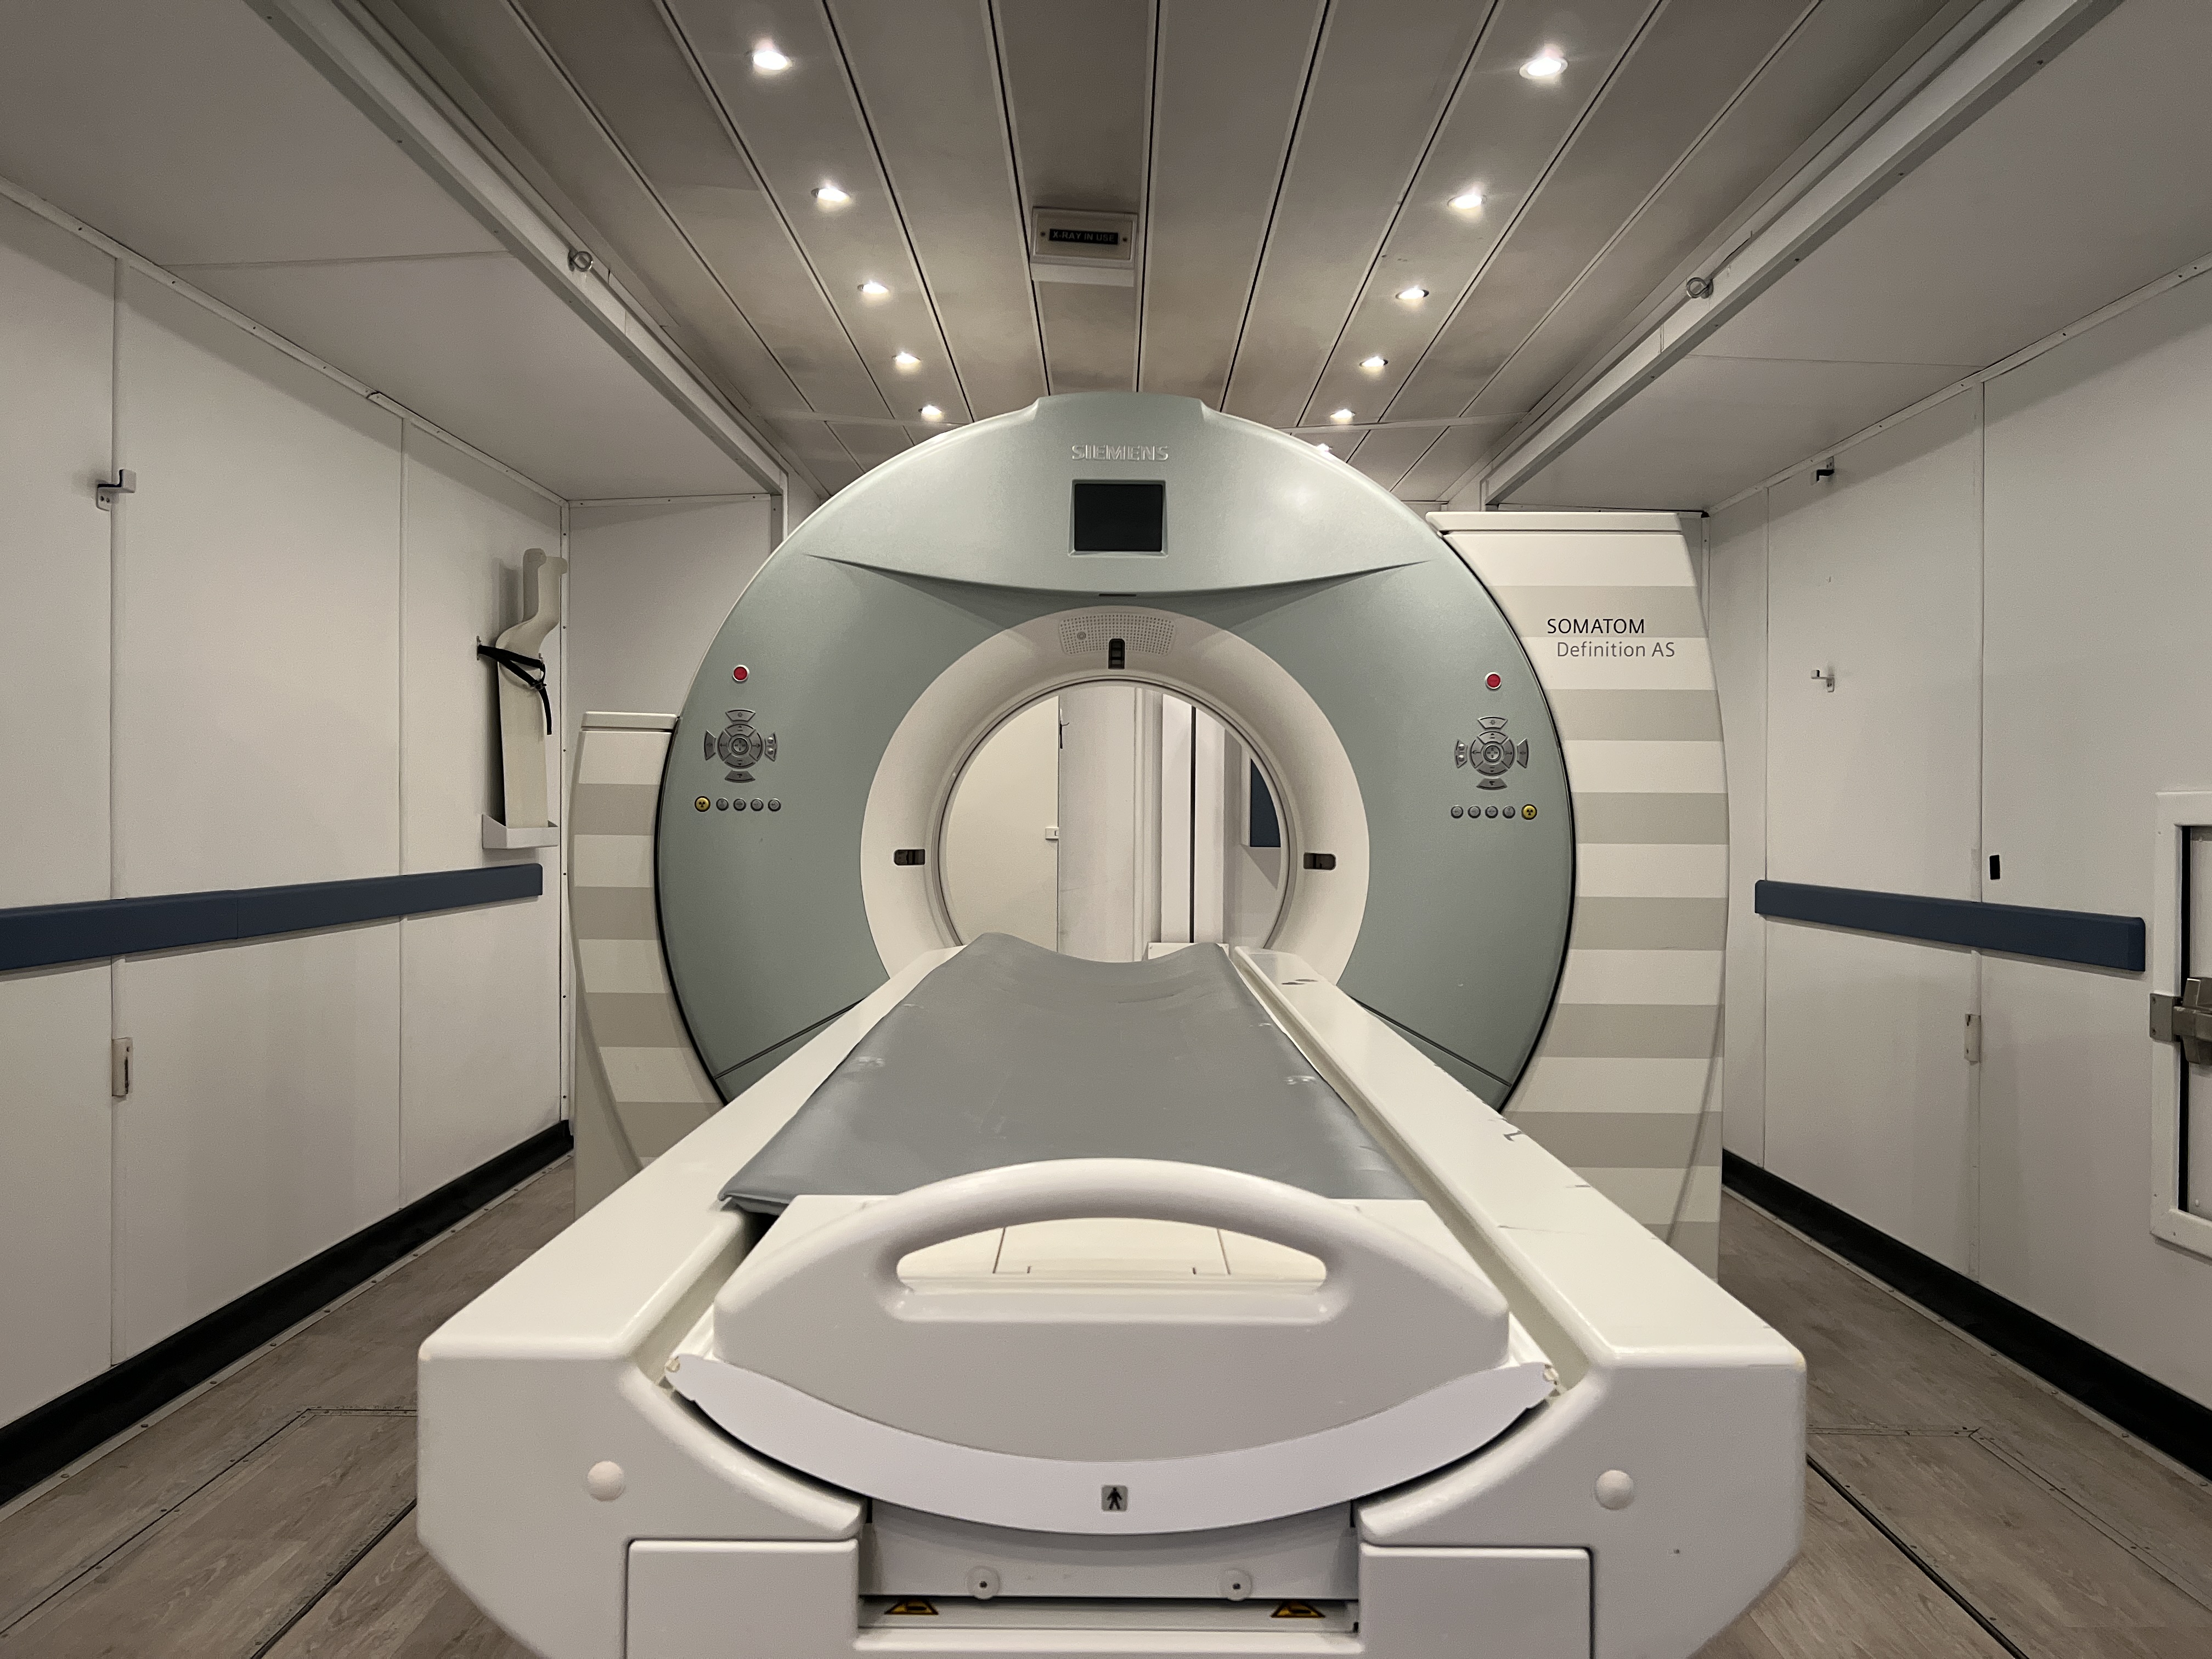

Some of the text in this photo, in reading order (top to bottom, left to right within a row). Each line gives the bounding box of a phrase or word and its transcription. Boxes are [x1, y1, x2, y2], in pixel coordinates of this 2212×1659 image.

[1053, 231, 1081, 239] X-RAY
[1096, 234, 1115, 242] USE
[1071, 444, 1169, 461] SIEMENS
[1547, 618, 1645, 634] SOMATOM
[1557, 641, 1675, 657] Definition AS
